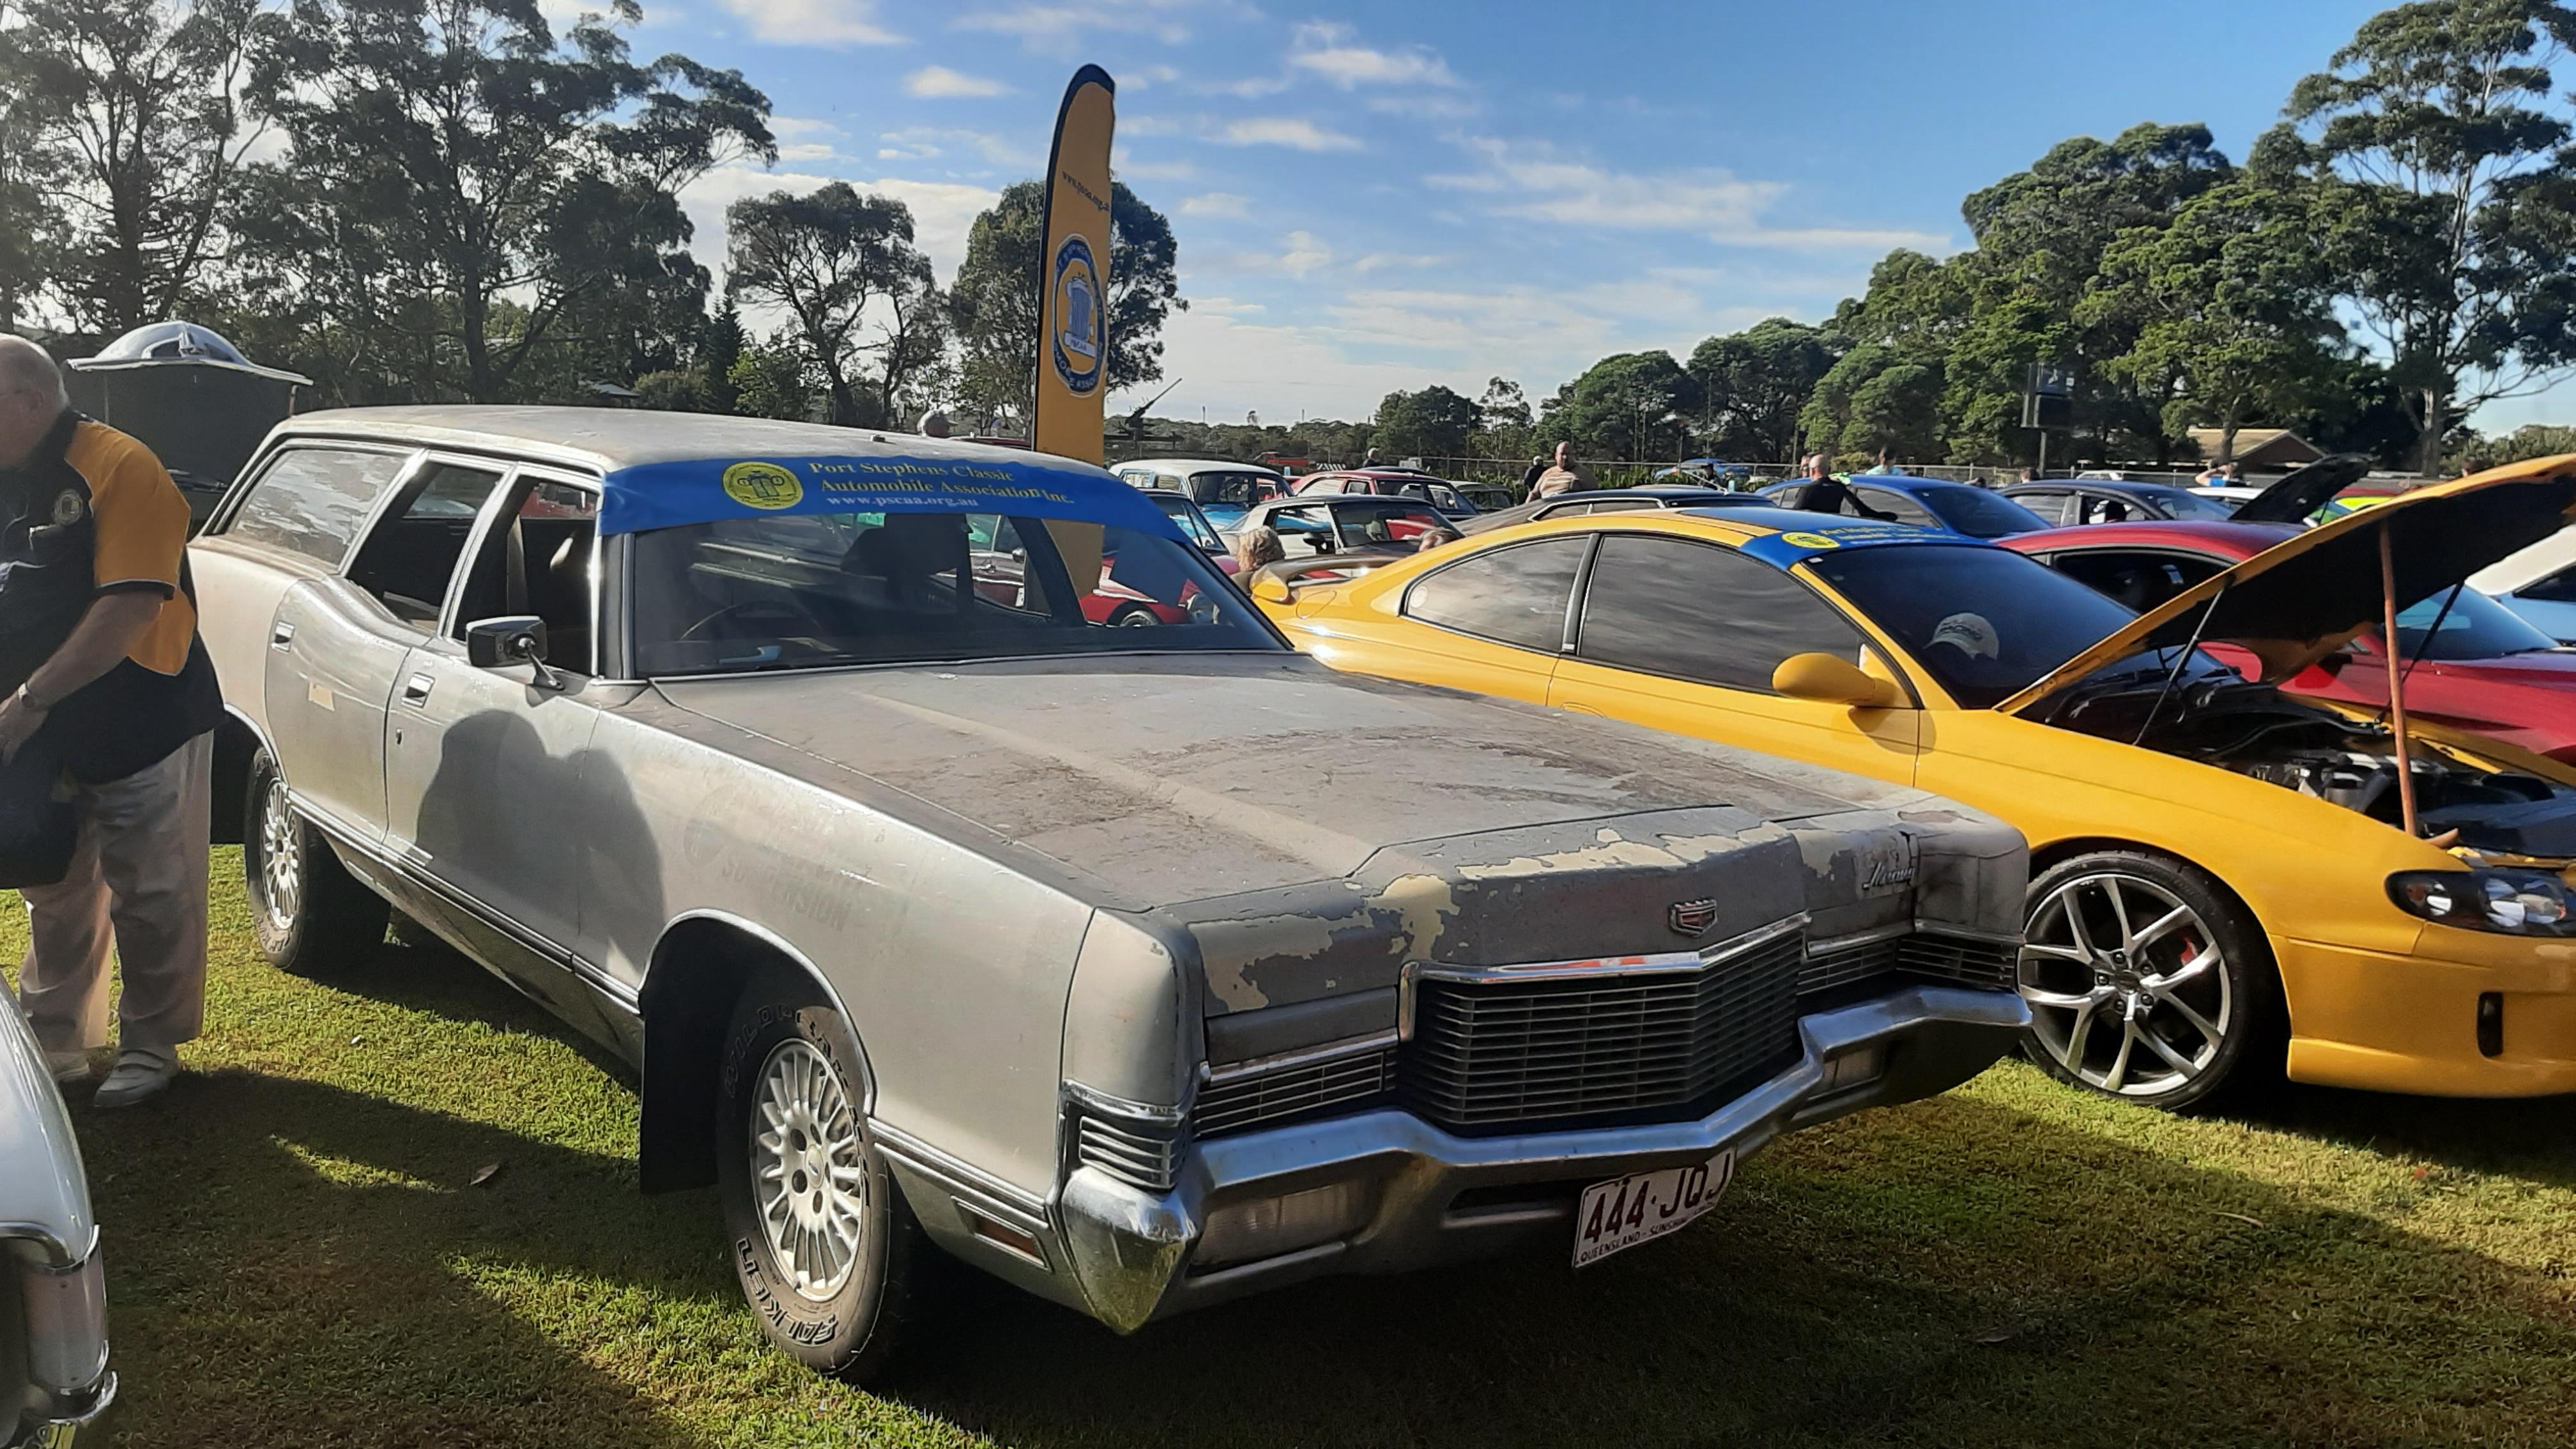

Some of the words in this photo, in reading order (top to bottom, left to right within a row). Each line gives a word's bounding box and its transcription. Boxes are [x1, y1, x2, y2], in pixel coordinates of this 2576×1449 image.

[808, 462, 857, 473] Port
[859, 463, 948, 477] Stephens
[952, 466, 1015, 481] Classic
[822, 479, 935, 493] Automobile
[941, 480, 1042, 498] Association
[1042, 489, 1075, 503] Inc.
[827, 496, 979, 507] www.pscaa.org.au
[1580, 1232, 1640, 1262] QUEENSLAND
